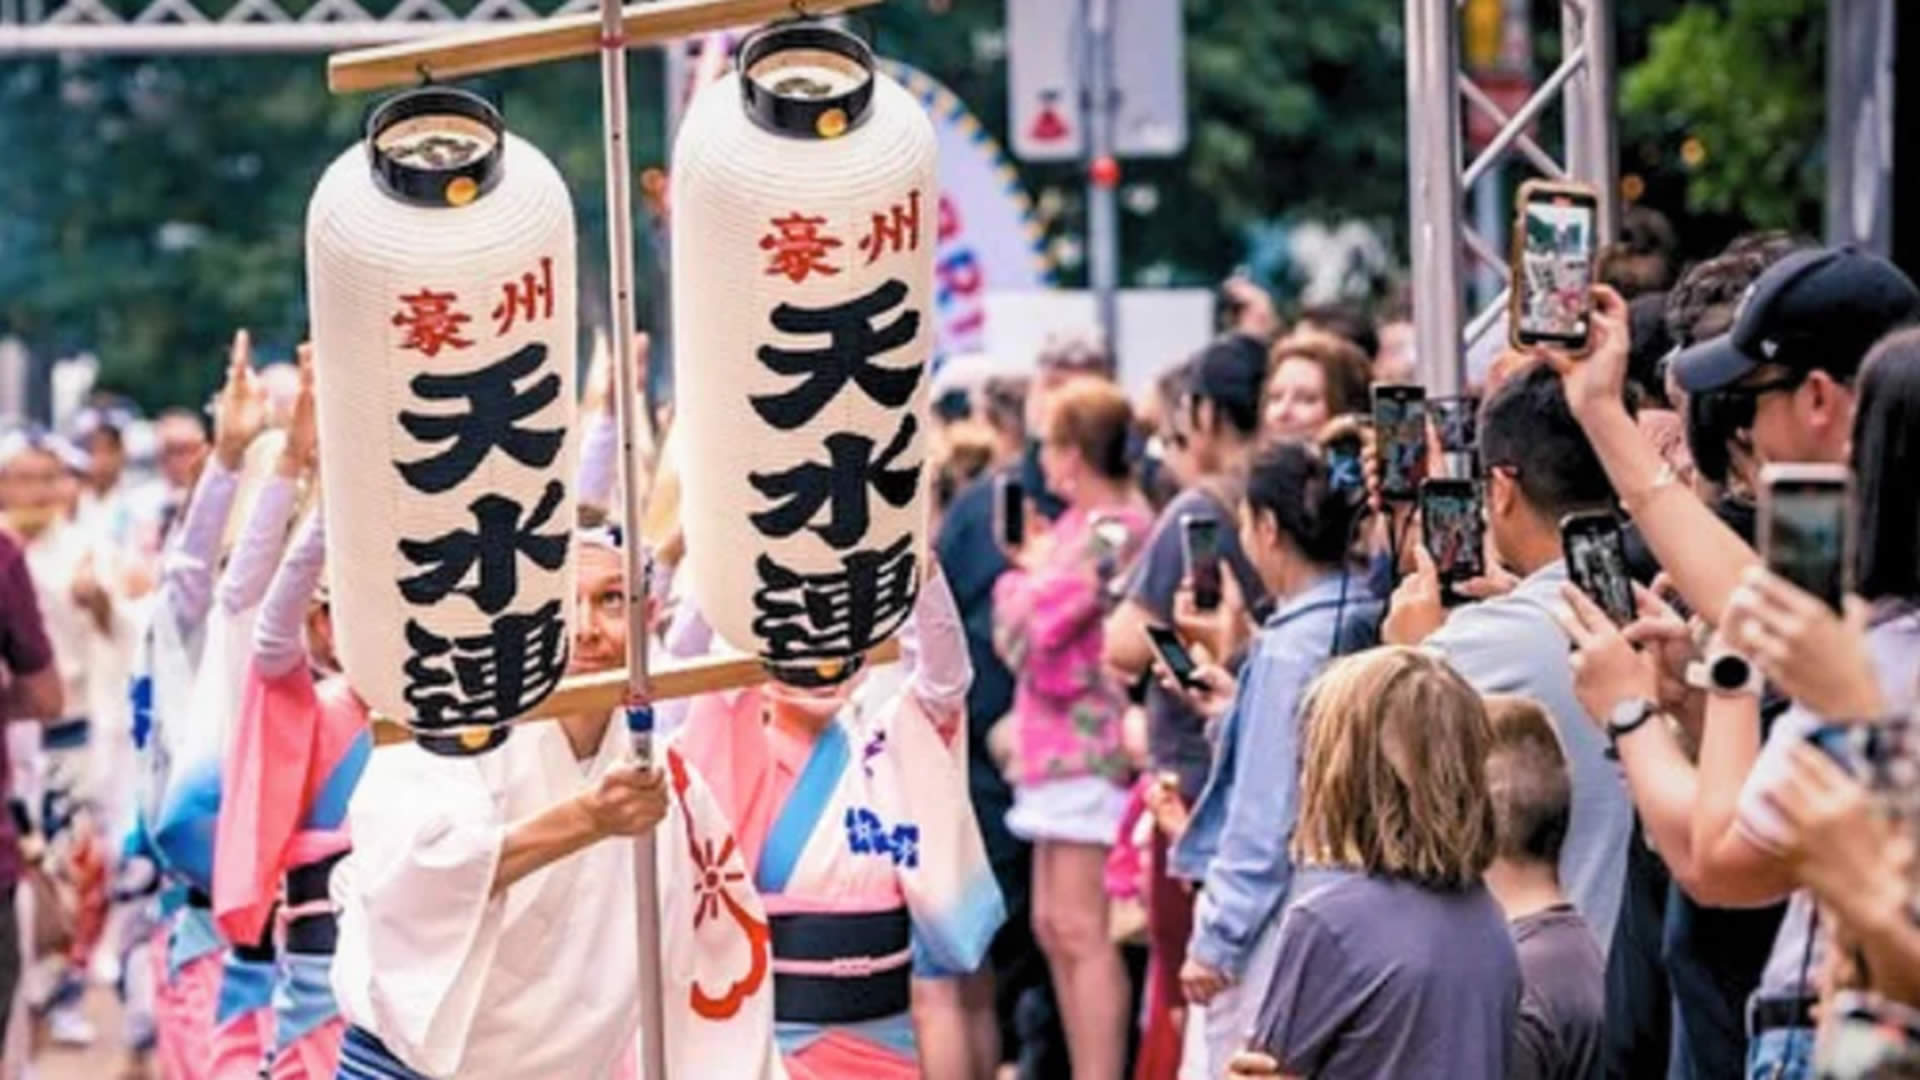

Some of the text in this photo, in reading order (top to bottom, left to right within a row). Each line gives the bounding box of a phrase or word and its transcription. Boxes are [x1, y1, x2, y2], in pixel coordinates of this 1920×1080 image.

[391, 257, 556, 358] 豪州
[758, 189, 922, 285] 豪州
[394, 342, 569, 729] 天水連
[748, 279, 922, 659] 天水連
